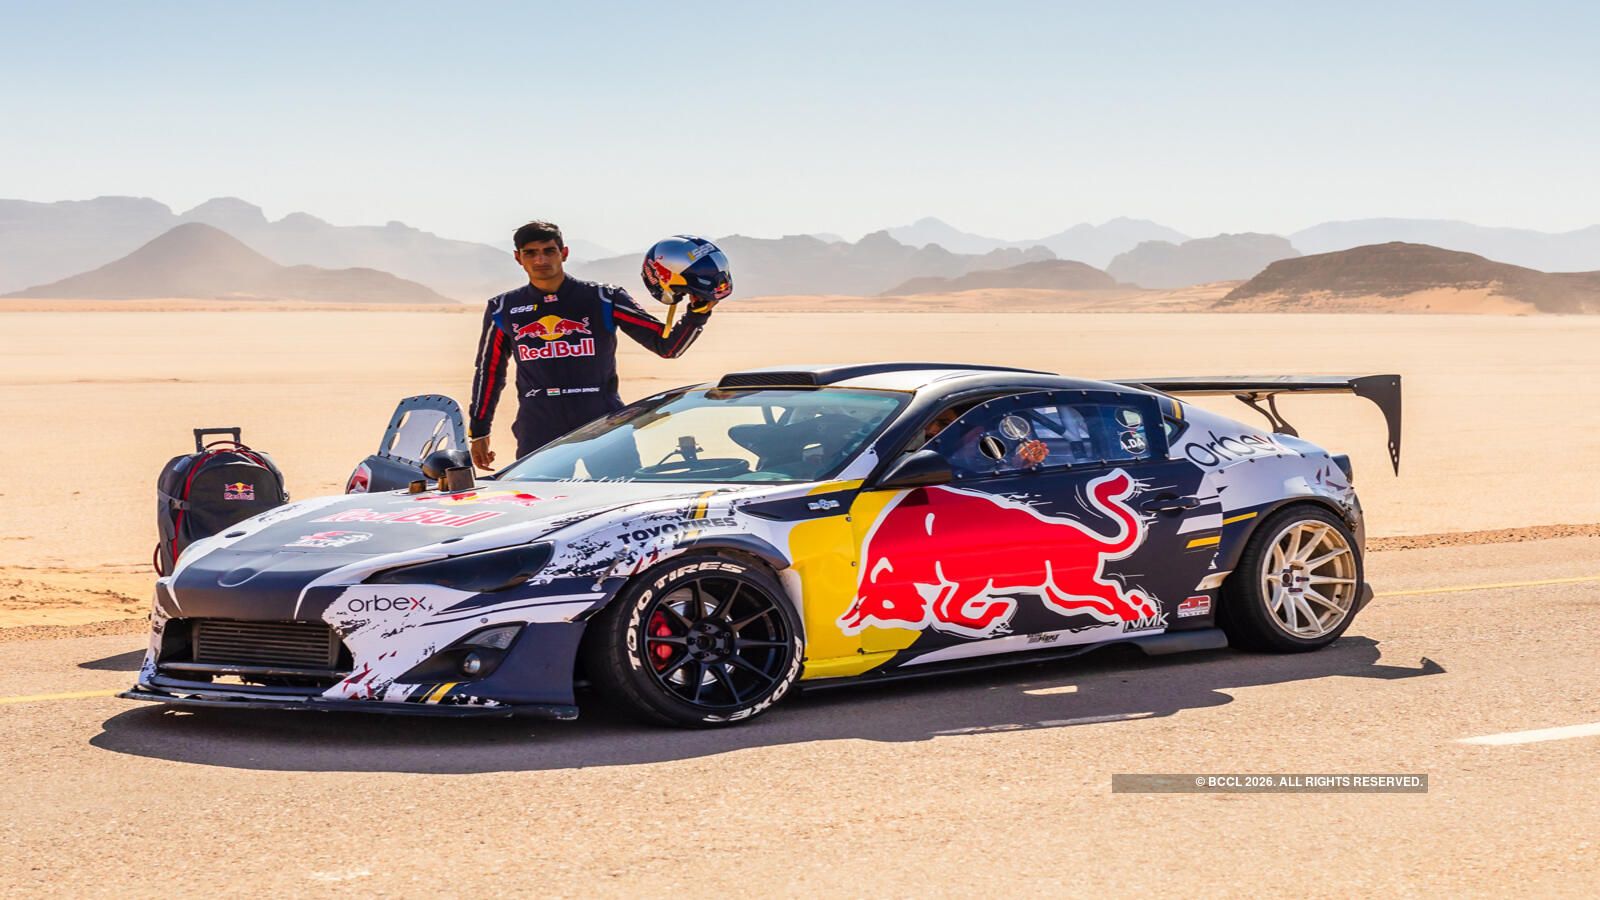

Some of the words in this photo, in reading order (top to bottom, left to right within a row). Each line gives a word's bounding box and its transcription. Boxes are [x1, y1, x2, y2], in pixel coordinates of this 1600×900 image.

[518, 341, 553, 361] Red
[553, 338, 595, 357] Bull
[388, 507, 506, 528] Bull
[617, 523, 678, 545] TOYO
[678, 517, 738, 531] TIRES
[347, 594, 427, 613] orbex
[627, 589, 653, 671] TOYO
[654, 561, 747, 589] TIRES
[1124, 612, 1170, 630] NMK
[702, 635, 803, 722] PROXES
